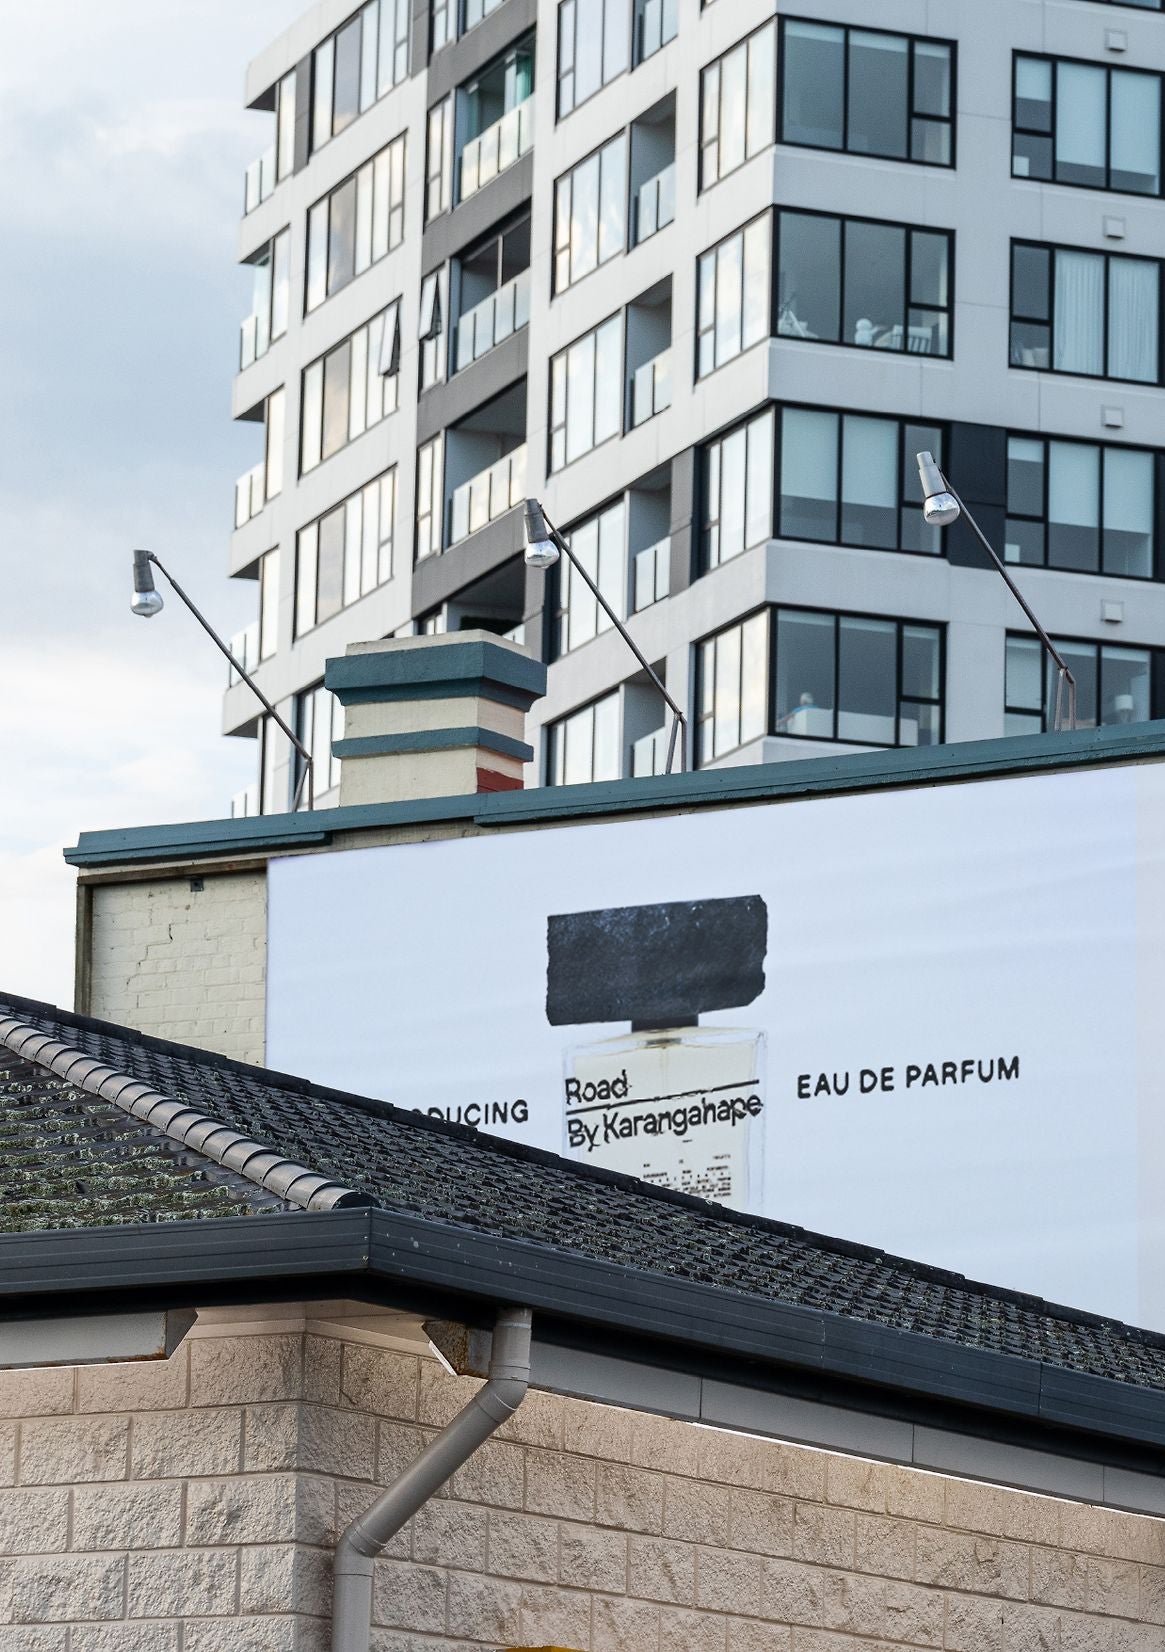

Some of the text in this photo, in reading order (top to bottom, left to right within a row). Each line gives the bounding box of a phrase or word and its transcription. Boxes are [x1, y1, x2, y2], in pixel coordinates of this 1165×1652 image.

[565, 1069, 629, 1105] Road
[797, 1056, 1019, 1099] EAU DE PARFUM
[568, 1094, 764, 1152] By Karangahape
